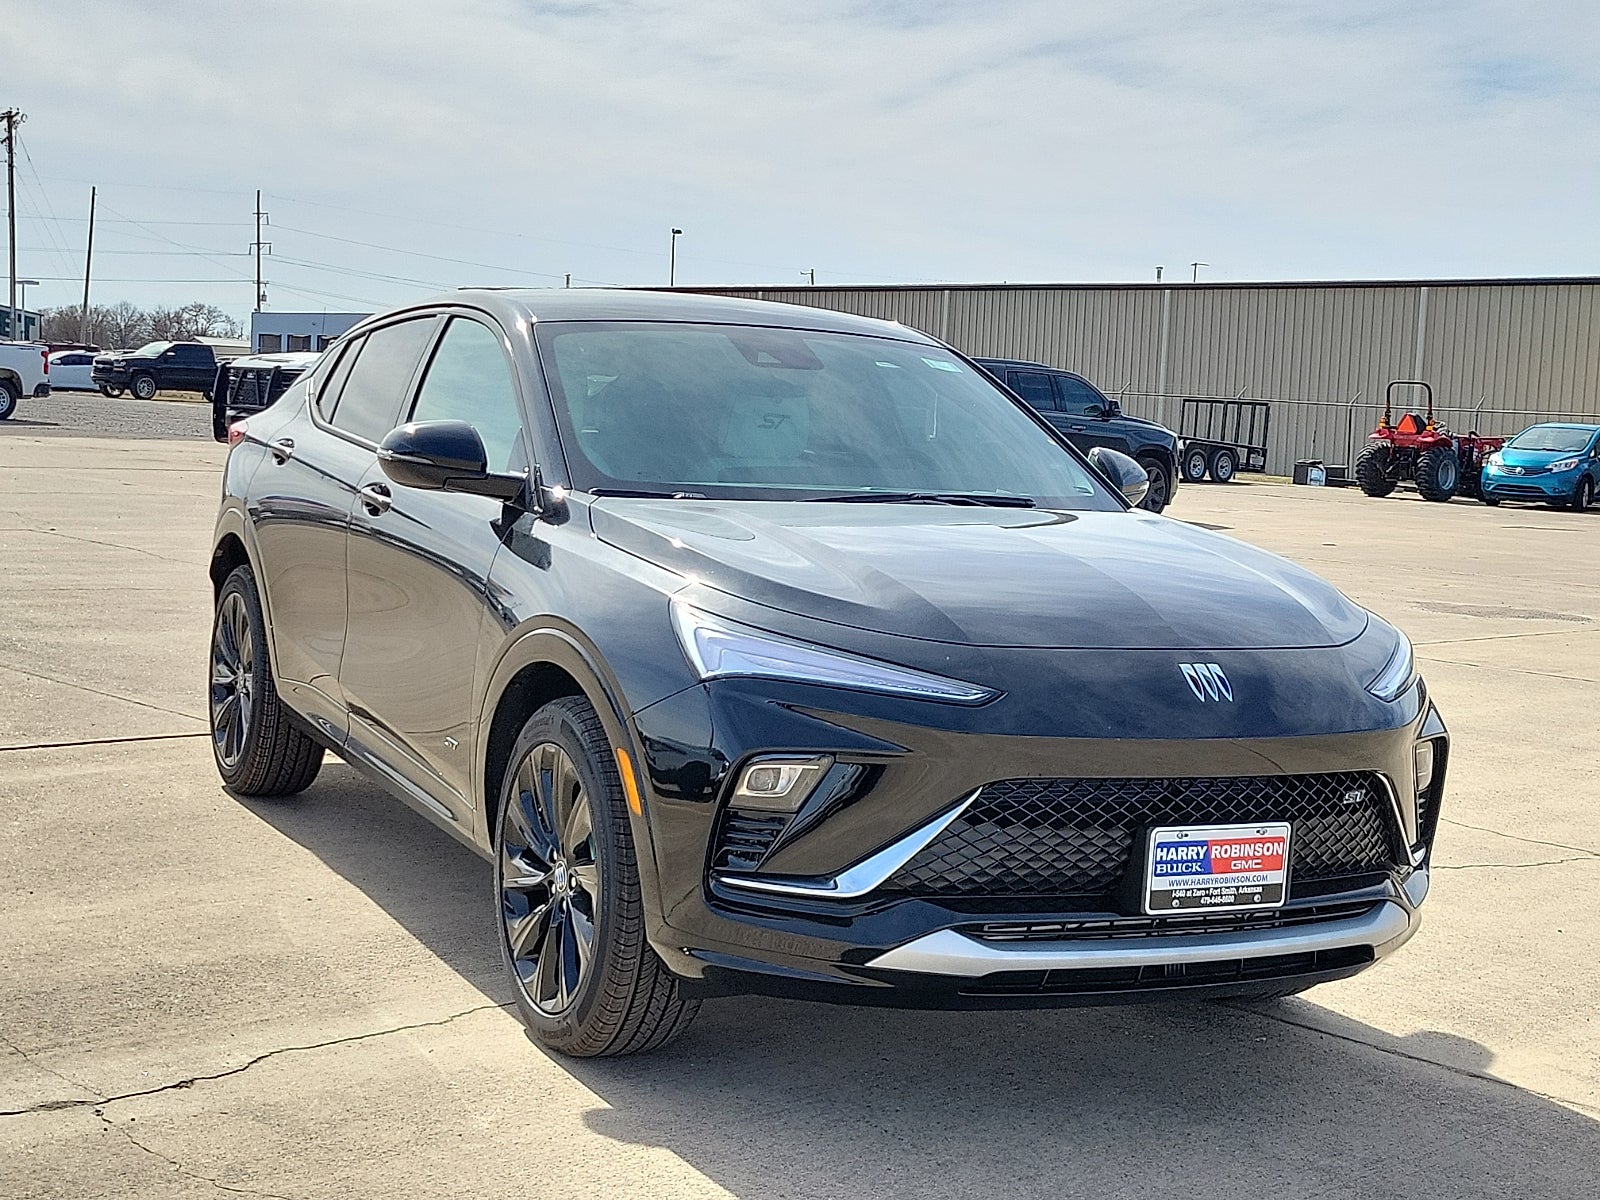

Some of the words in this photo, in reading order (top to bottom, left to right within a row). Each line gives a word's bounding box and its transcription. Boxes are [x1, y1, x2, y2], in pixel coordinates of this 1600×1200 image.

[1156, 845, 1208, 861] HARRY
[1211, 841, 1283, 859] ROBINSON
[1156, 862, 1202, 874] BUICK
[1230, 859, 1263, 870] GMC
[1168, 875, 1268, 888] WWW.HARRYROBINSON.COM
[1209, 887, 1221, 896] Fort
[1238, 886, 1263, 894] Arkansas
